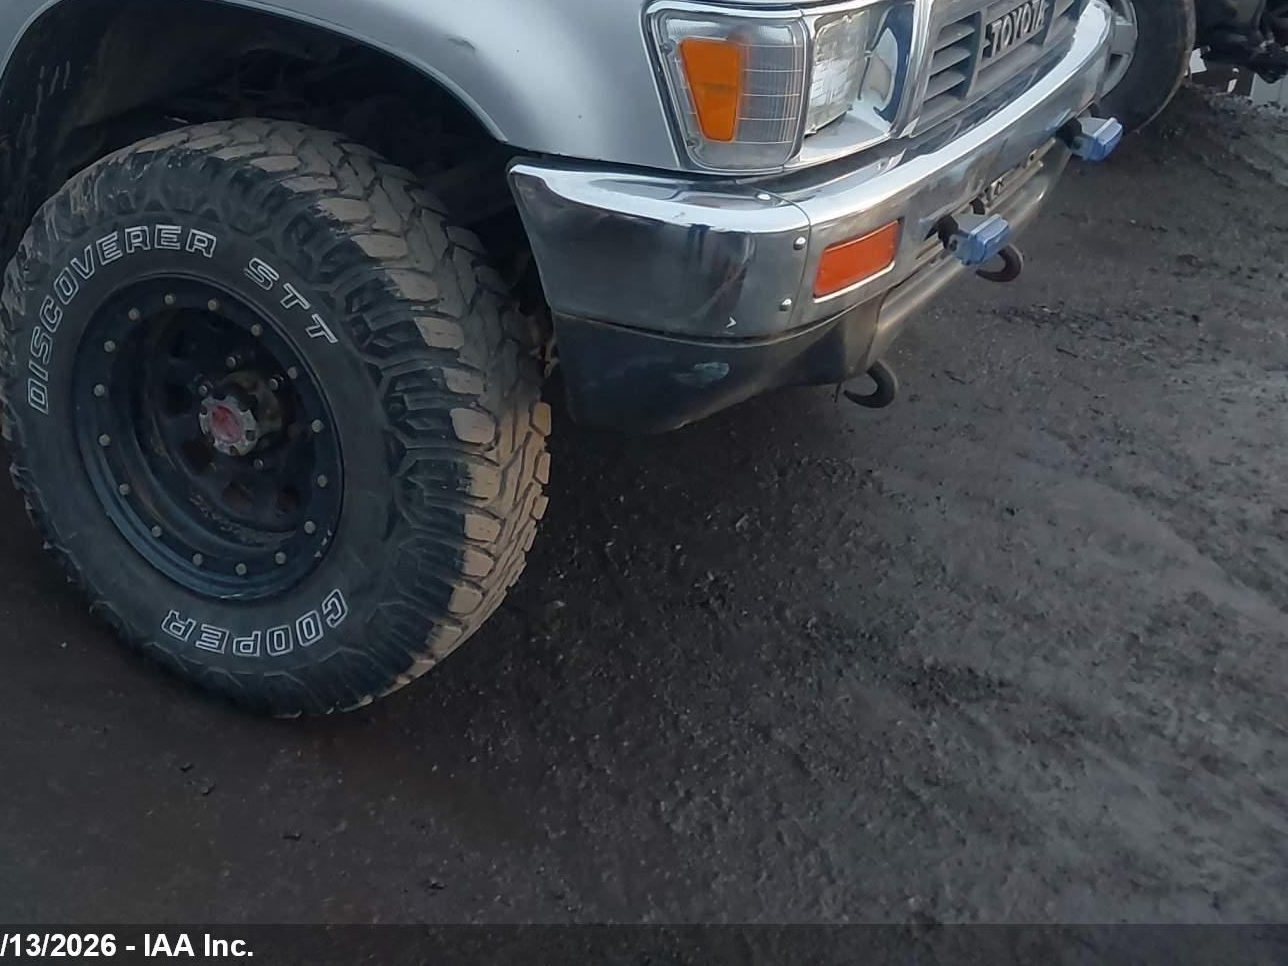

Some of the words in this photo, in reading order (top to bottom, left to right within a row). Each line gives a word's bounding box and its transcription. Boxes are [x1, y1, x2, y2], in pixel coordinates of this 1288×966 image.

[27, 223, 218, 416] DISCOVERER
[244, 257, 339, 347] STT
[161, 587, 350, 658] COOPER
